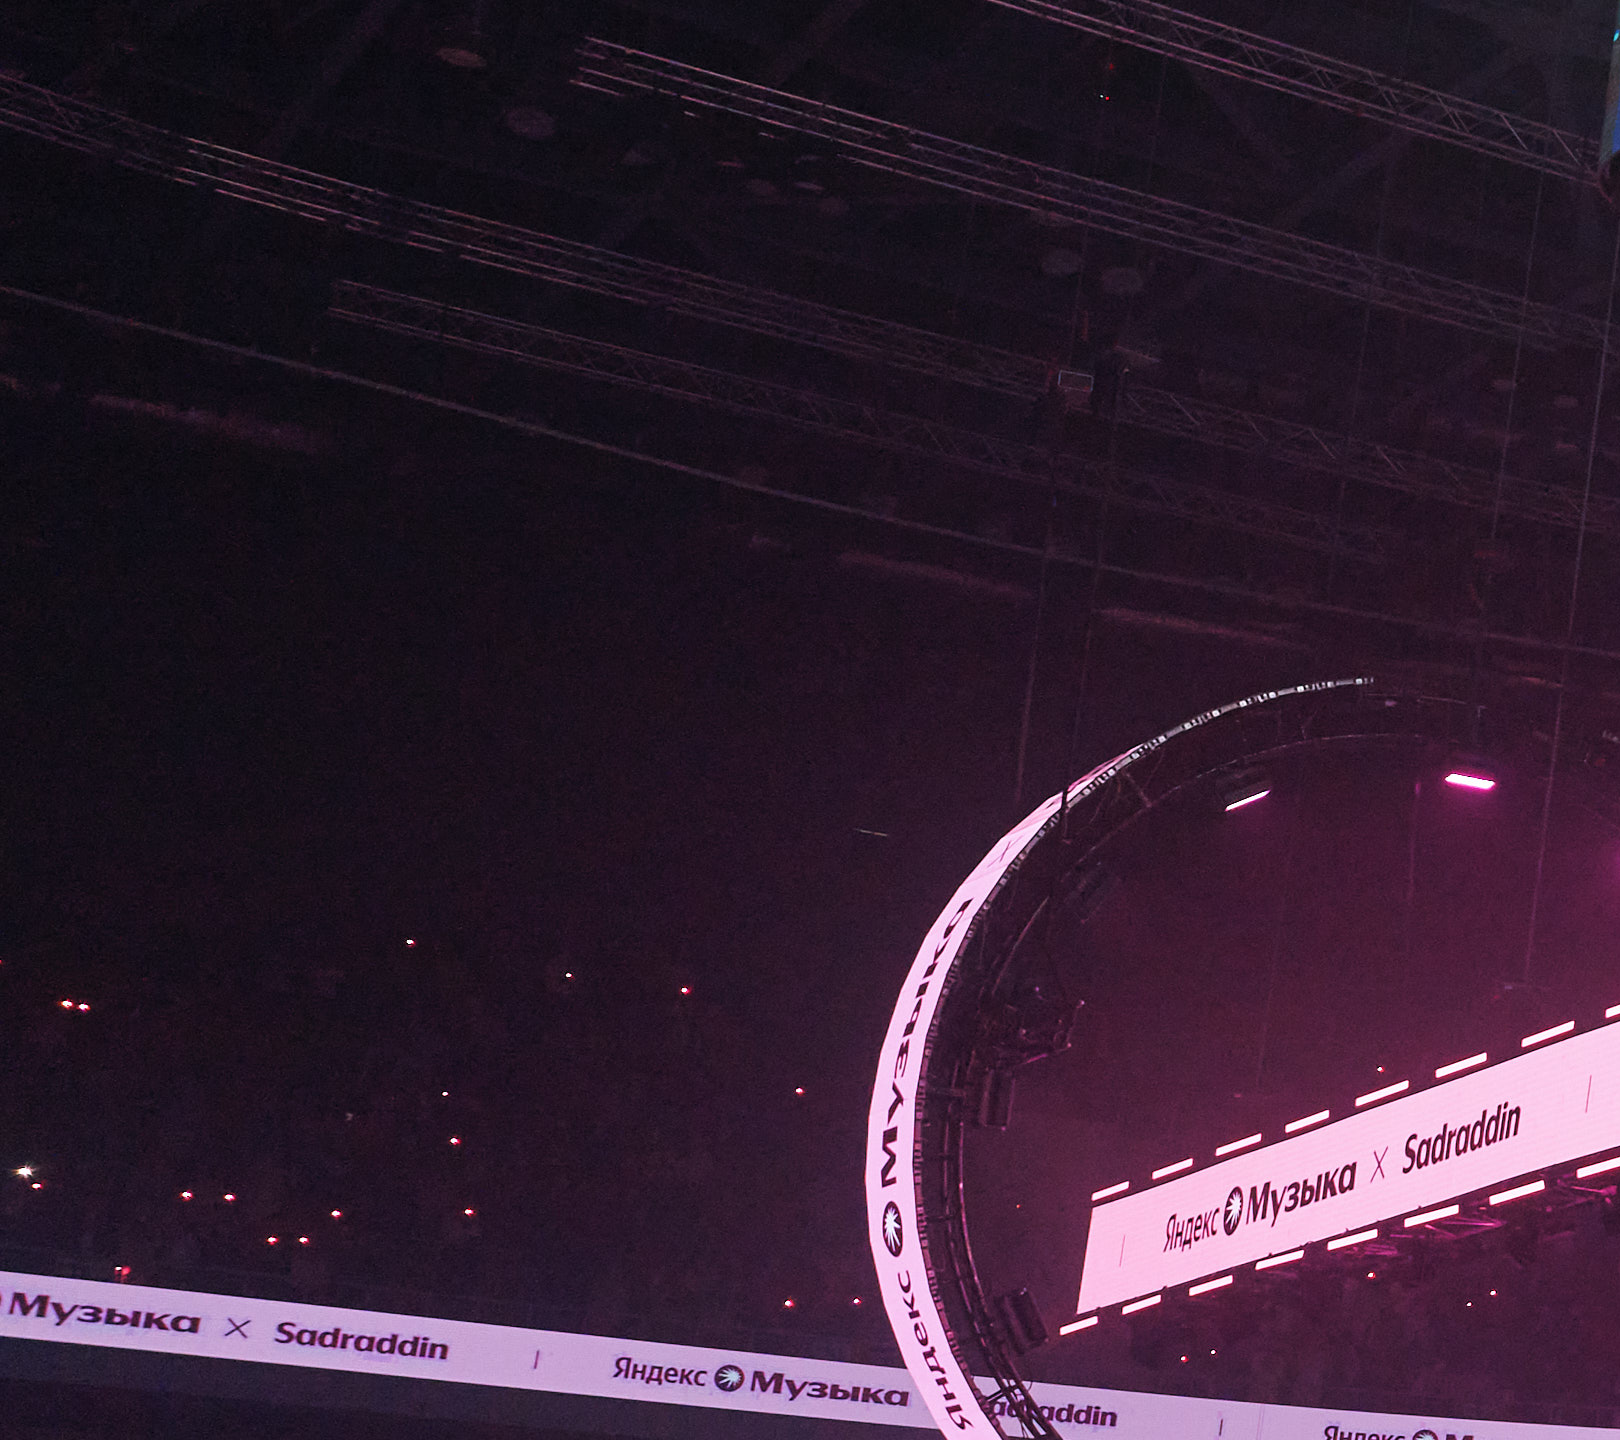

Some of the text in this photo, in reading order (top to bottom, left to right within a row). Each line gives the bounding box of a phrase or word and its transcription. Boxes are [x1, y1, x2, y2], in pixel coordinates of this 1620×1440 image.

[880, 897, 974, 1430] Яндекс Музыка
[1164, 1208, 1220, 1252] Яндекс
[1250, 1162, 1357, 1227] Музыка
[1403, 1102, 1521, 1174] Sadraddin
[8, 1292, 201, 1333] Музыка
[275, 1322, 448, 1360] Sadraddin
[613, 1357, 707, 1386] Яндекс
[751, 1371, 909, 1406] Музыка
